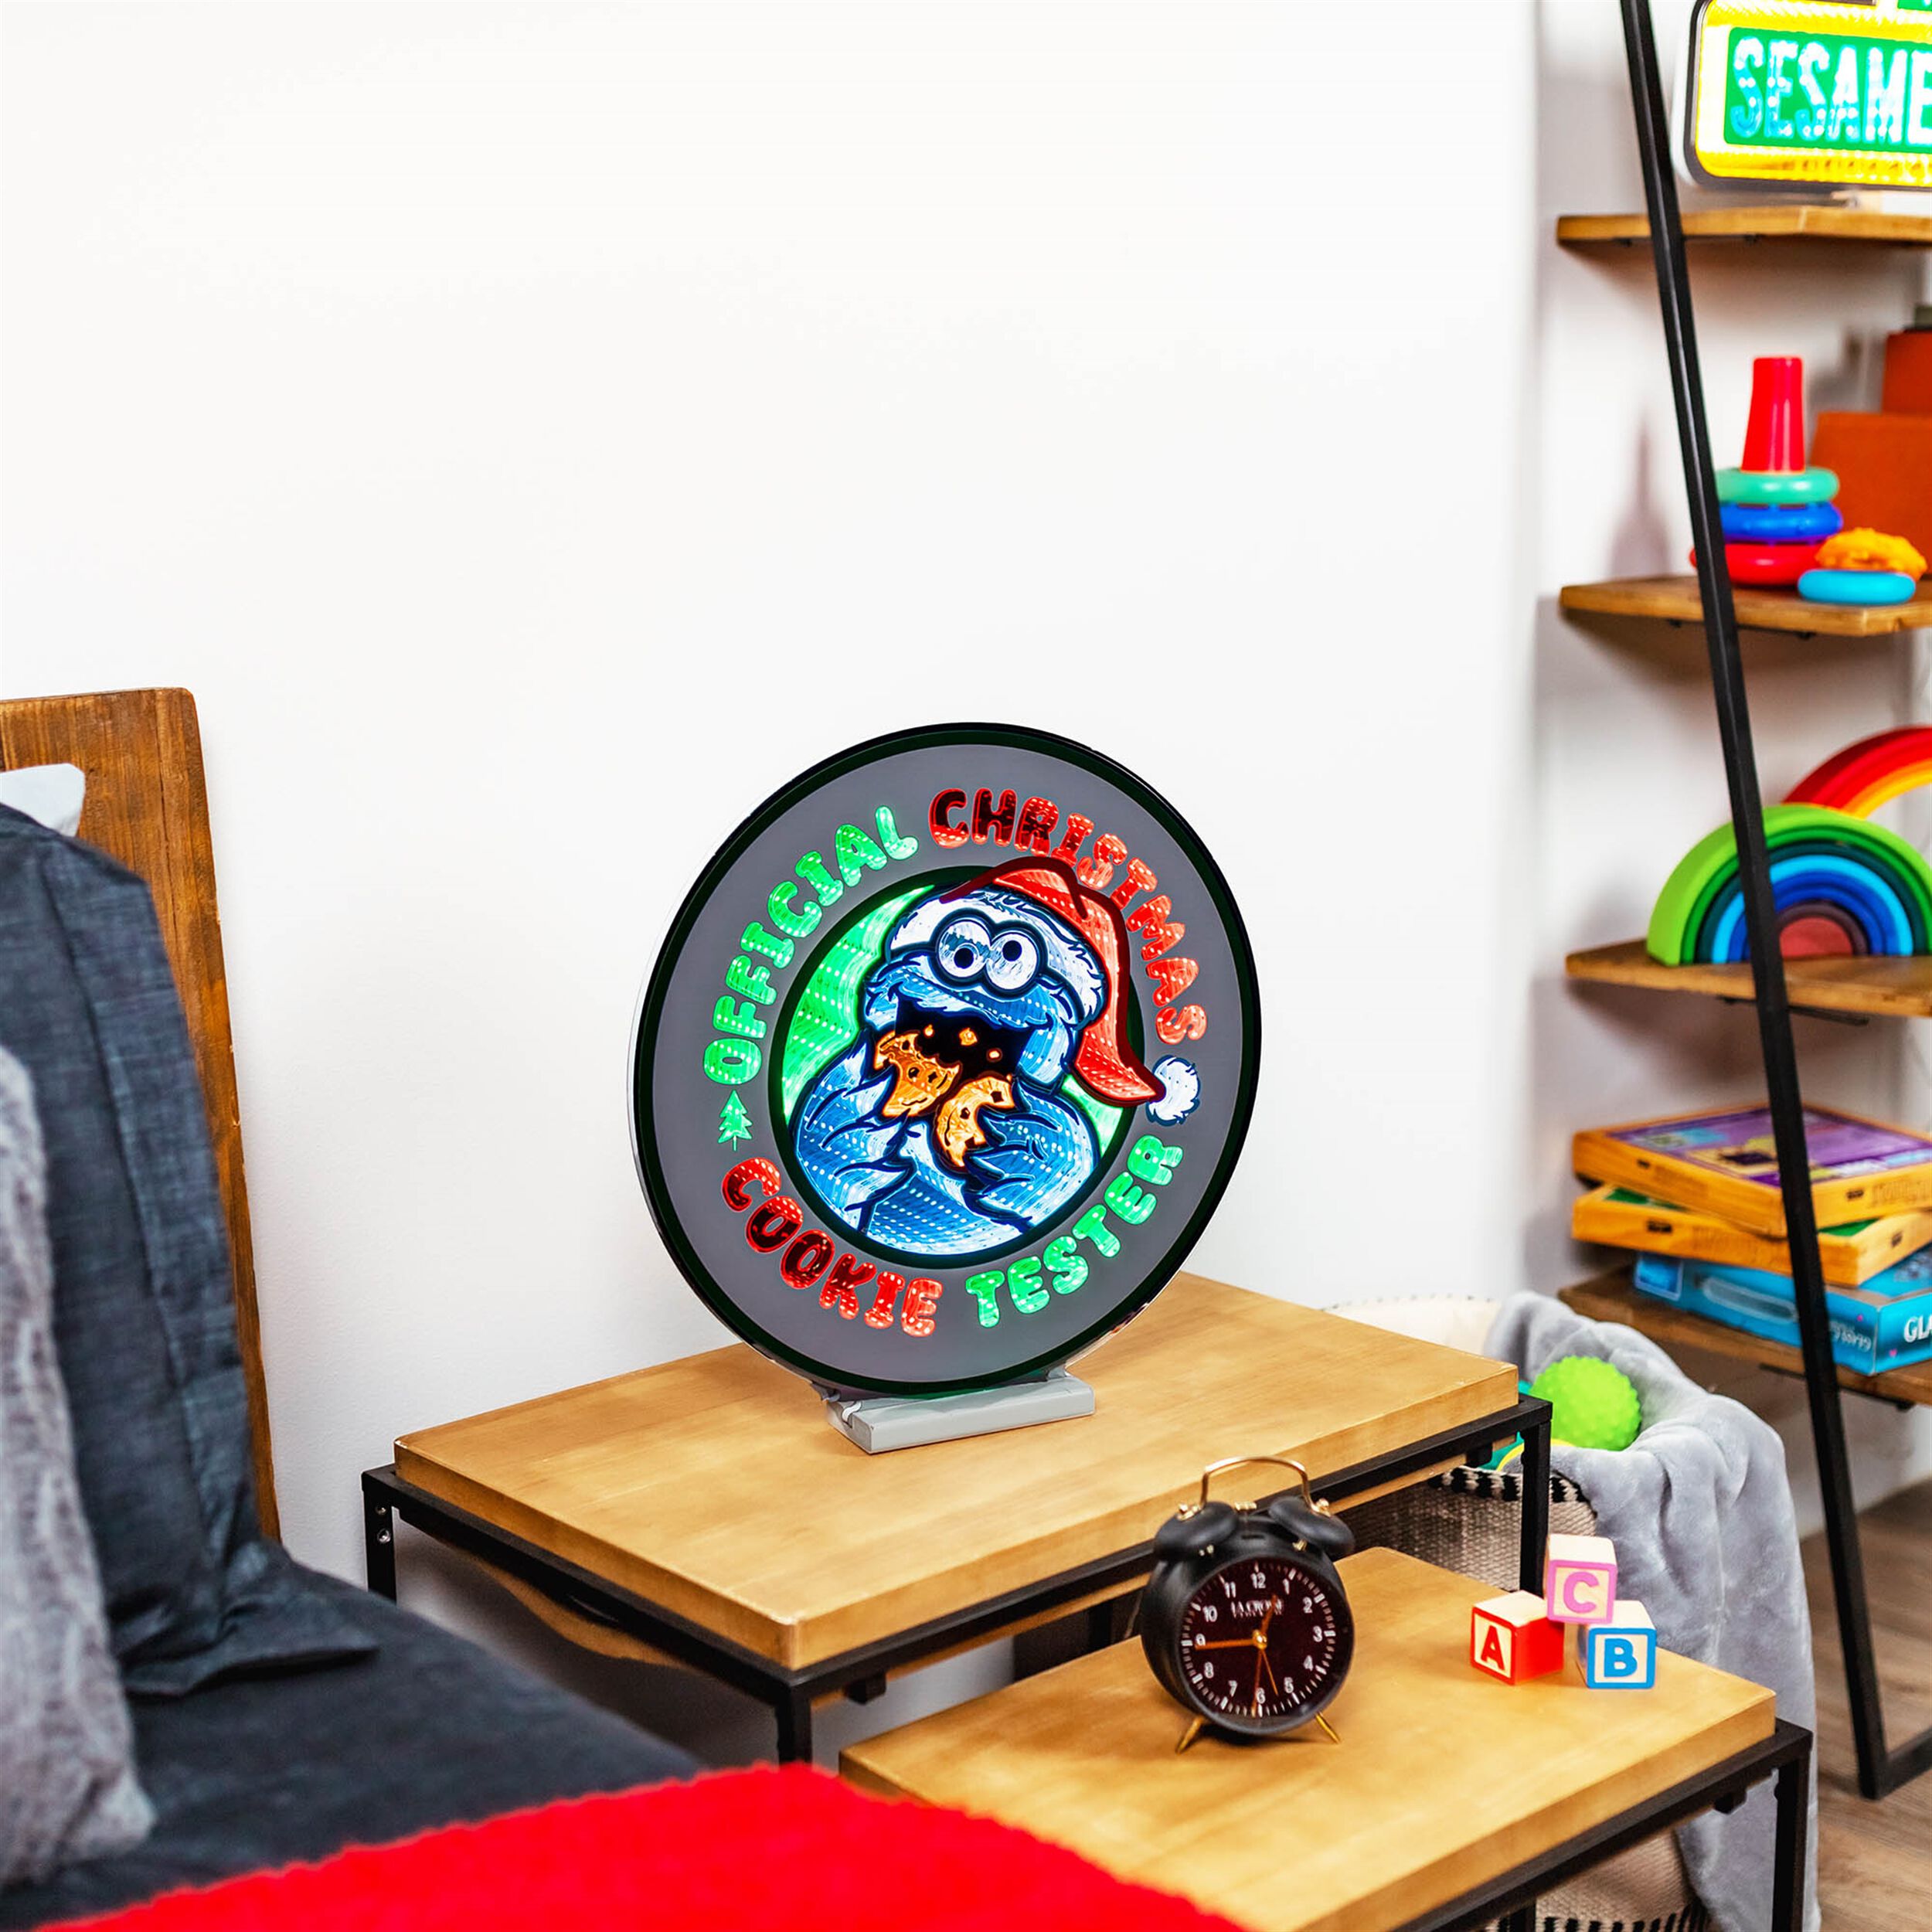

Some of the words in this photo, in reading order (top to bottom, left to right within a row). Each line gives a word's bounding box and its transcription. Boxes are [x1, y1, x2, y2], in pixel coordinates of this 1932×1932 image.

[1730, 36, 1932, 145] SESAME
[703, 805, 918, 1085] OFFICIAL
[929, 788, 1207, 1045] CHRISTMAS
[721, 1157, 943, 1338] COOKIE
[966, 1134, 1183, 1328] TESTER
[1250, 1572, 1266, 1589] 12
[1282, 1578, 1290, 1594] 1
[1224, 1581, 1236, 1598] 11
[1563, 1571, 1599, 1614] C
[1202, 1605, 1218, 1622] 10
[1303, 1597, 1313, 1614] 2
[1196, 1633, 1206, 1647] 9
[1313, 1626, 1323, 1642] 3
[1481, 1625, 1505, 1671] A
[1303, 1655, 1314, 1672] 4
[1604, 1638, 1638, 1678] B
[1204, 1662, 1214, 1679] 8
[1228, 1680, 1237, 1697] 7
[1284, 1676, 1294, 1694] 5
[1256, 1687, 1266, 1704] 6
